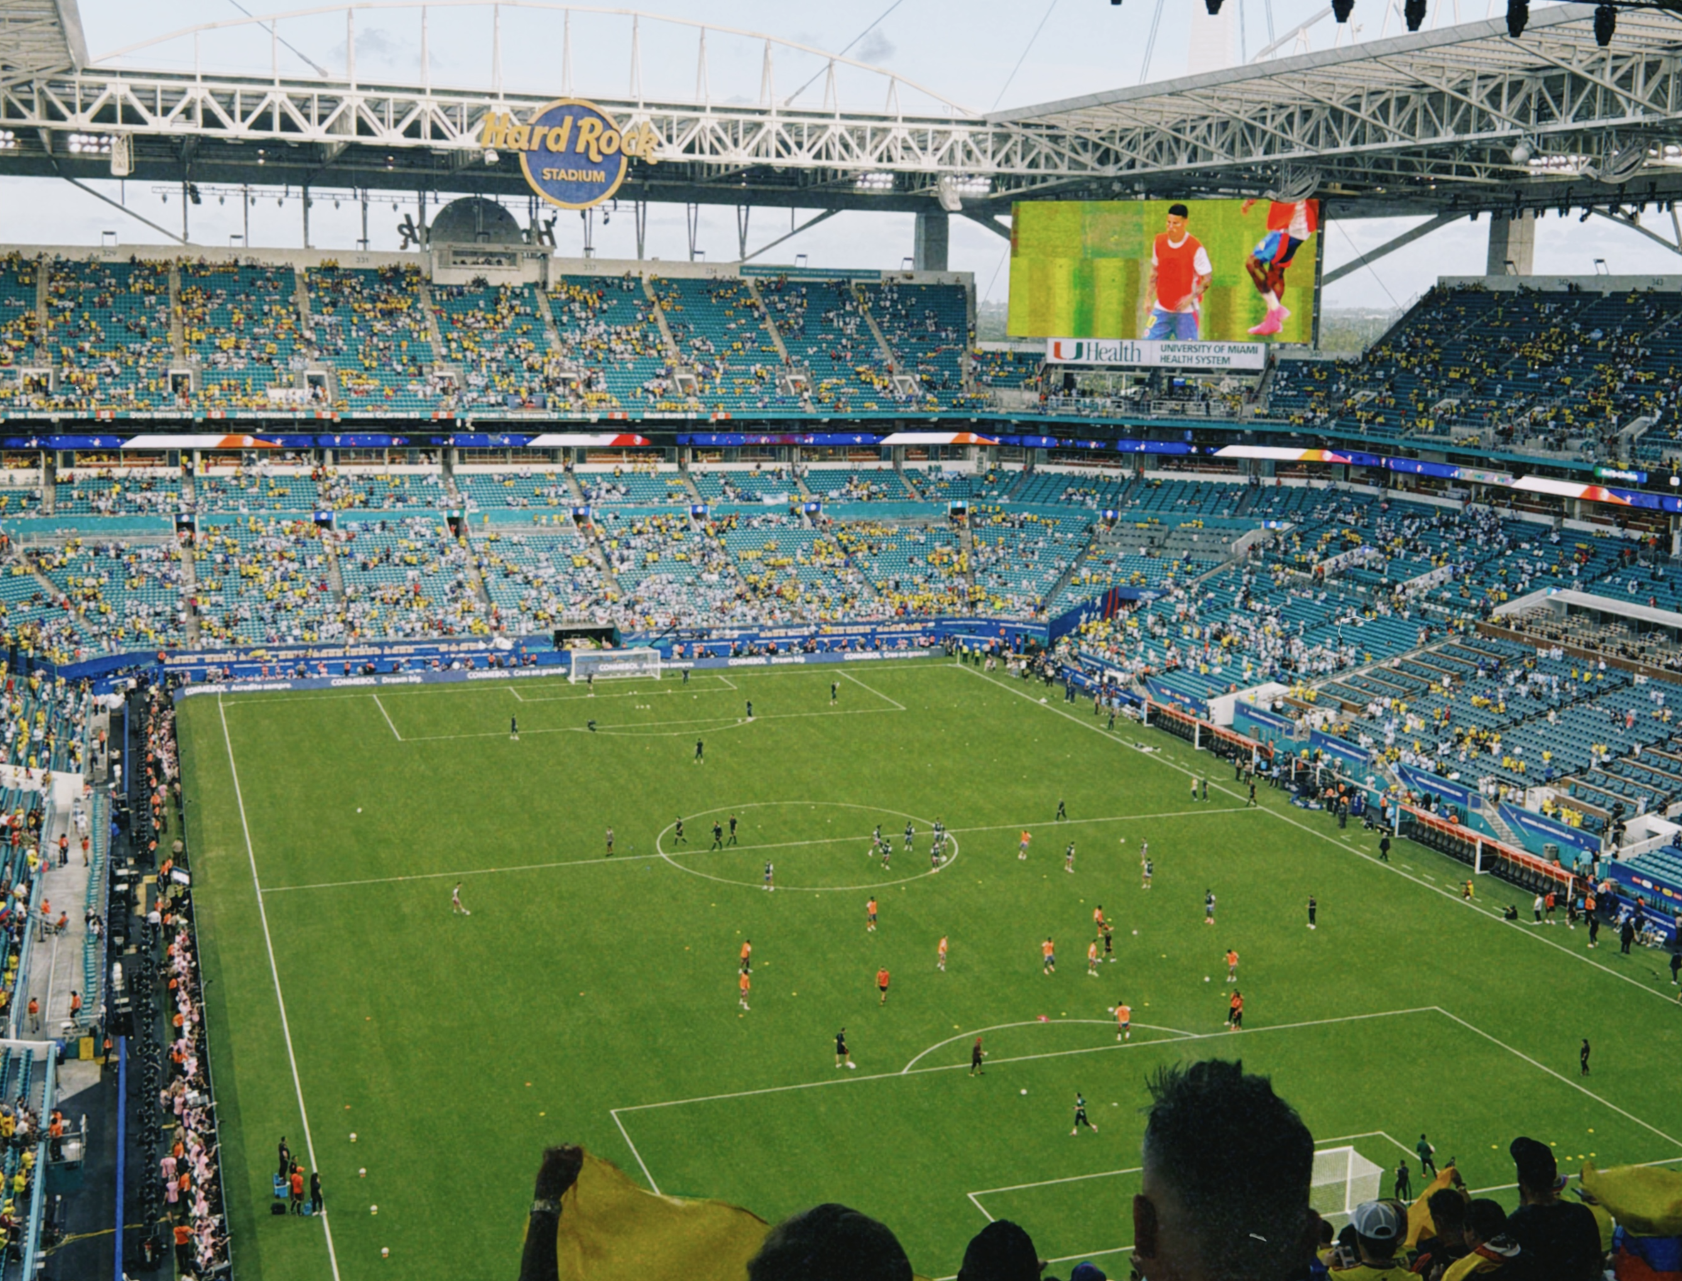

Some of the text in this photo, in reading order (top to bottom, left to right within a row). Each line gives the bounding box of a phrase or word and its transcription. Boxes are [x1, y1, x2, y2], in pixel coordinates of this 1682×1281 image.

[481, 112, 658, 165] Hard Rock
[542, 168, 606, 183] STADIUM
[1160, 344, 1259, 355] UNIVERSITY OF MIAMI
[1160, 354, 1231, 365] HEALTH SYSTEM
[728, 656, 767, 666] CONMEBOL
[843, 651, 882, 660] CONMEBOL
[466, 669, 511, 679] CONMEBOL
[331, 676, 377, 686] CONMEBOL
[381, 676, 407, 684] Dream
[184, 683, 228, 695] CONMEBOL
